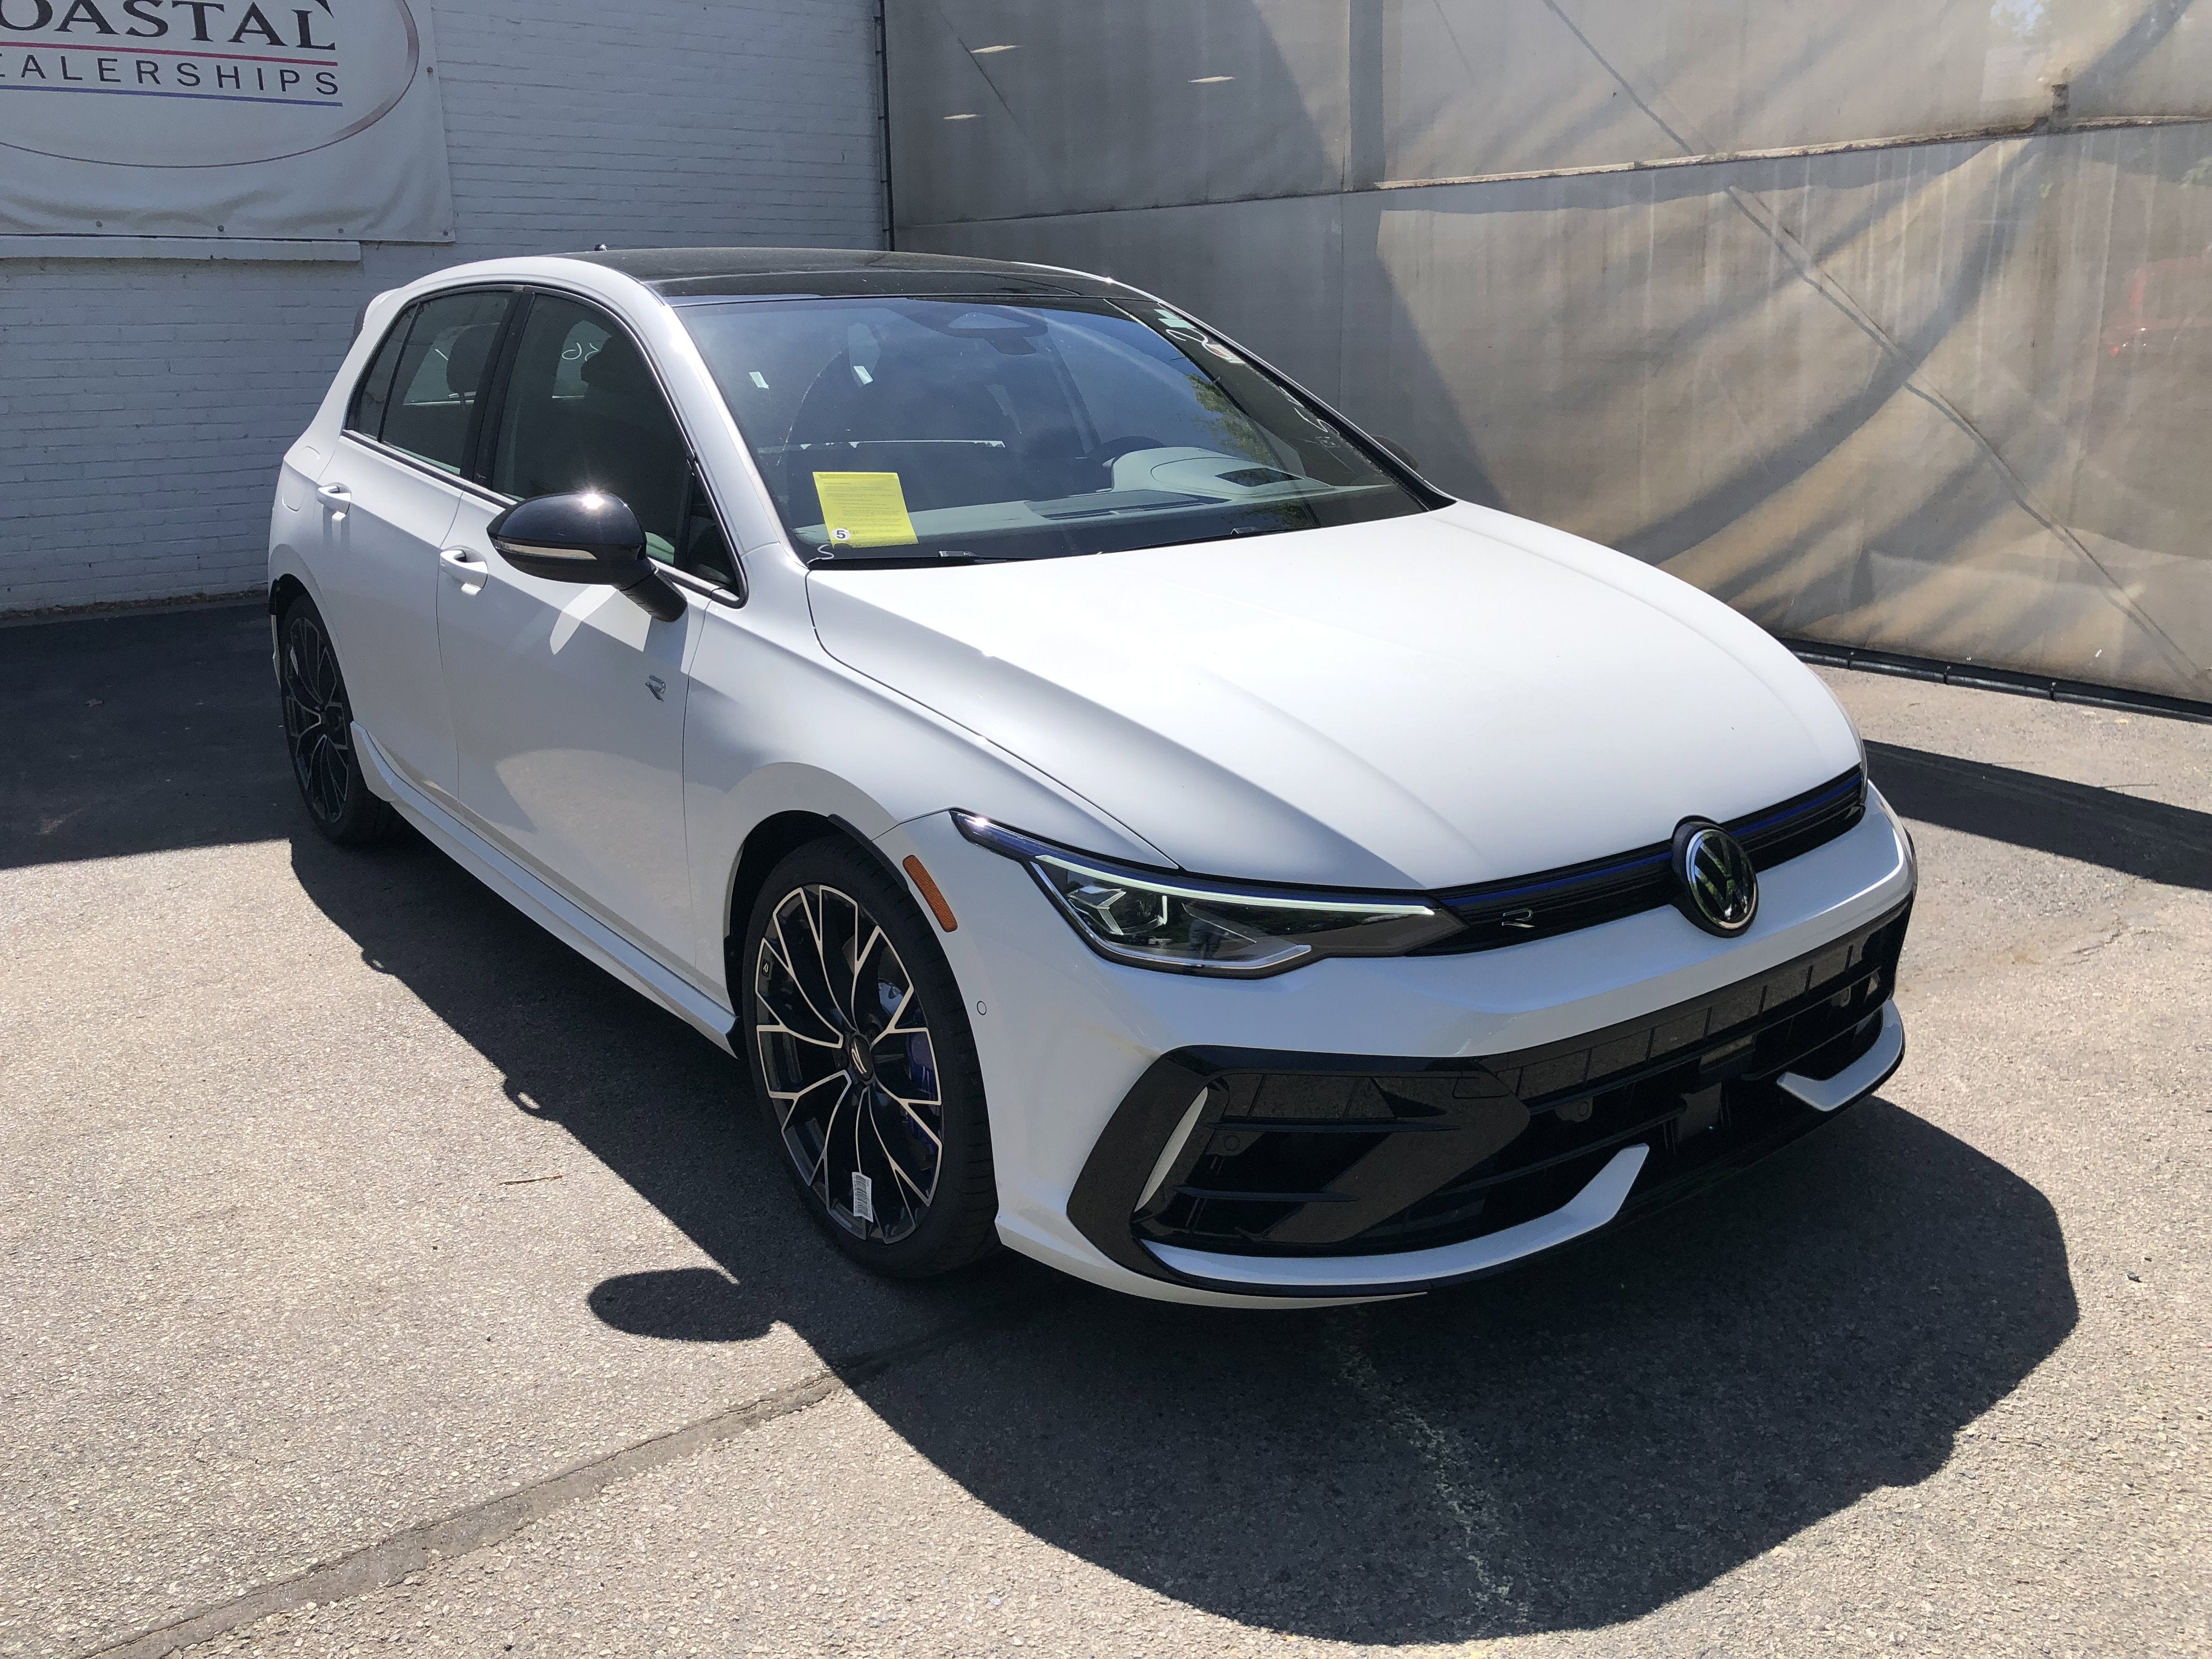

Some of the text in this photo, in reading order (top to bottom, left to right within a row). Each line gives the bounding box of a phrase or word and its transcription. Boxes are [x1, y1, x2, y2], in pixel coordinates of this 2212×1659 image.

[0, 53, 338, 95] ALERSHIPS
[836, 530, 846, 539] 5
[1502, 908, 1536, 928] R
